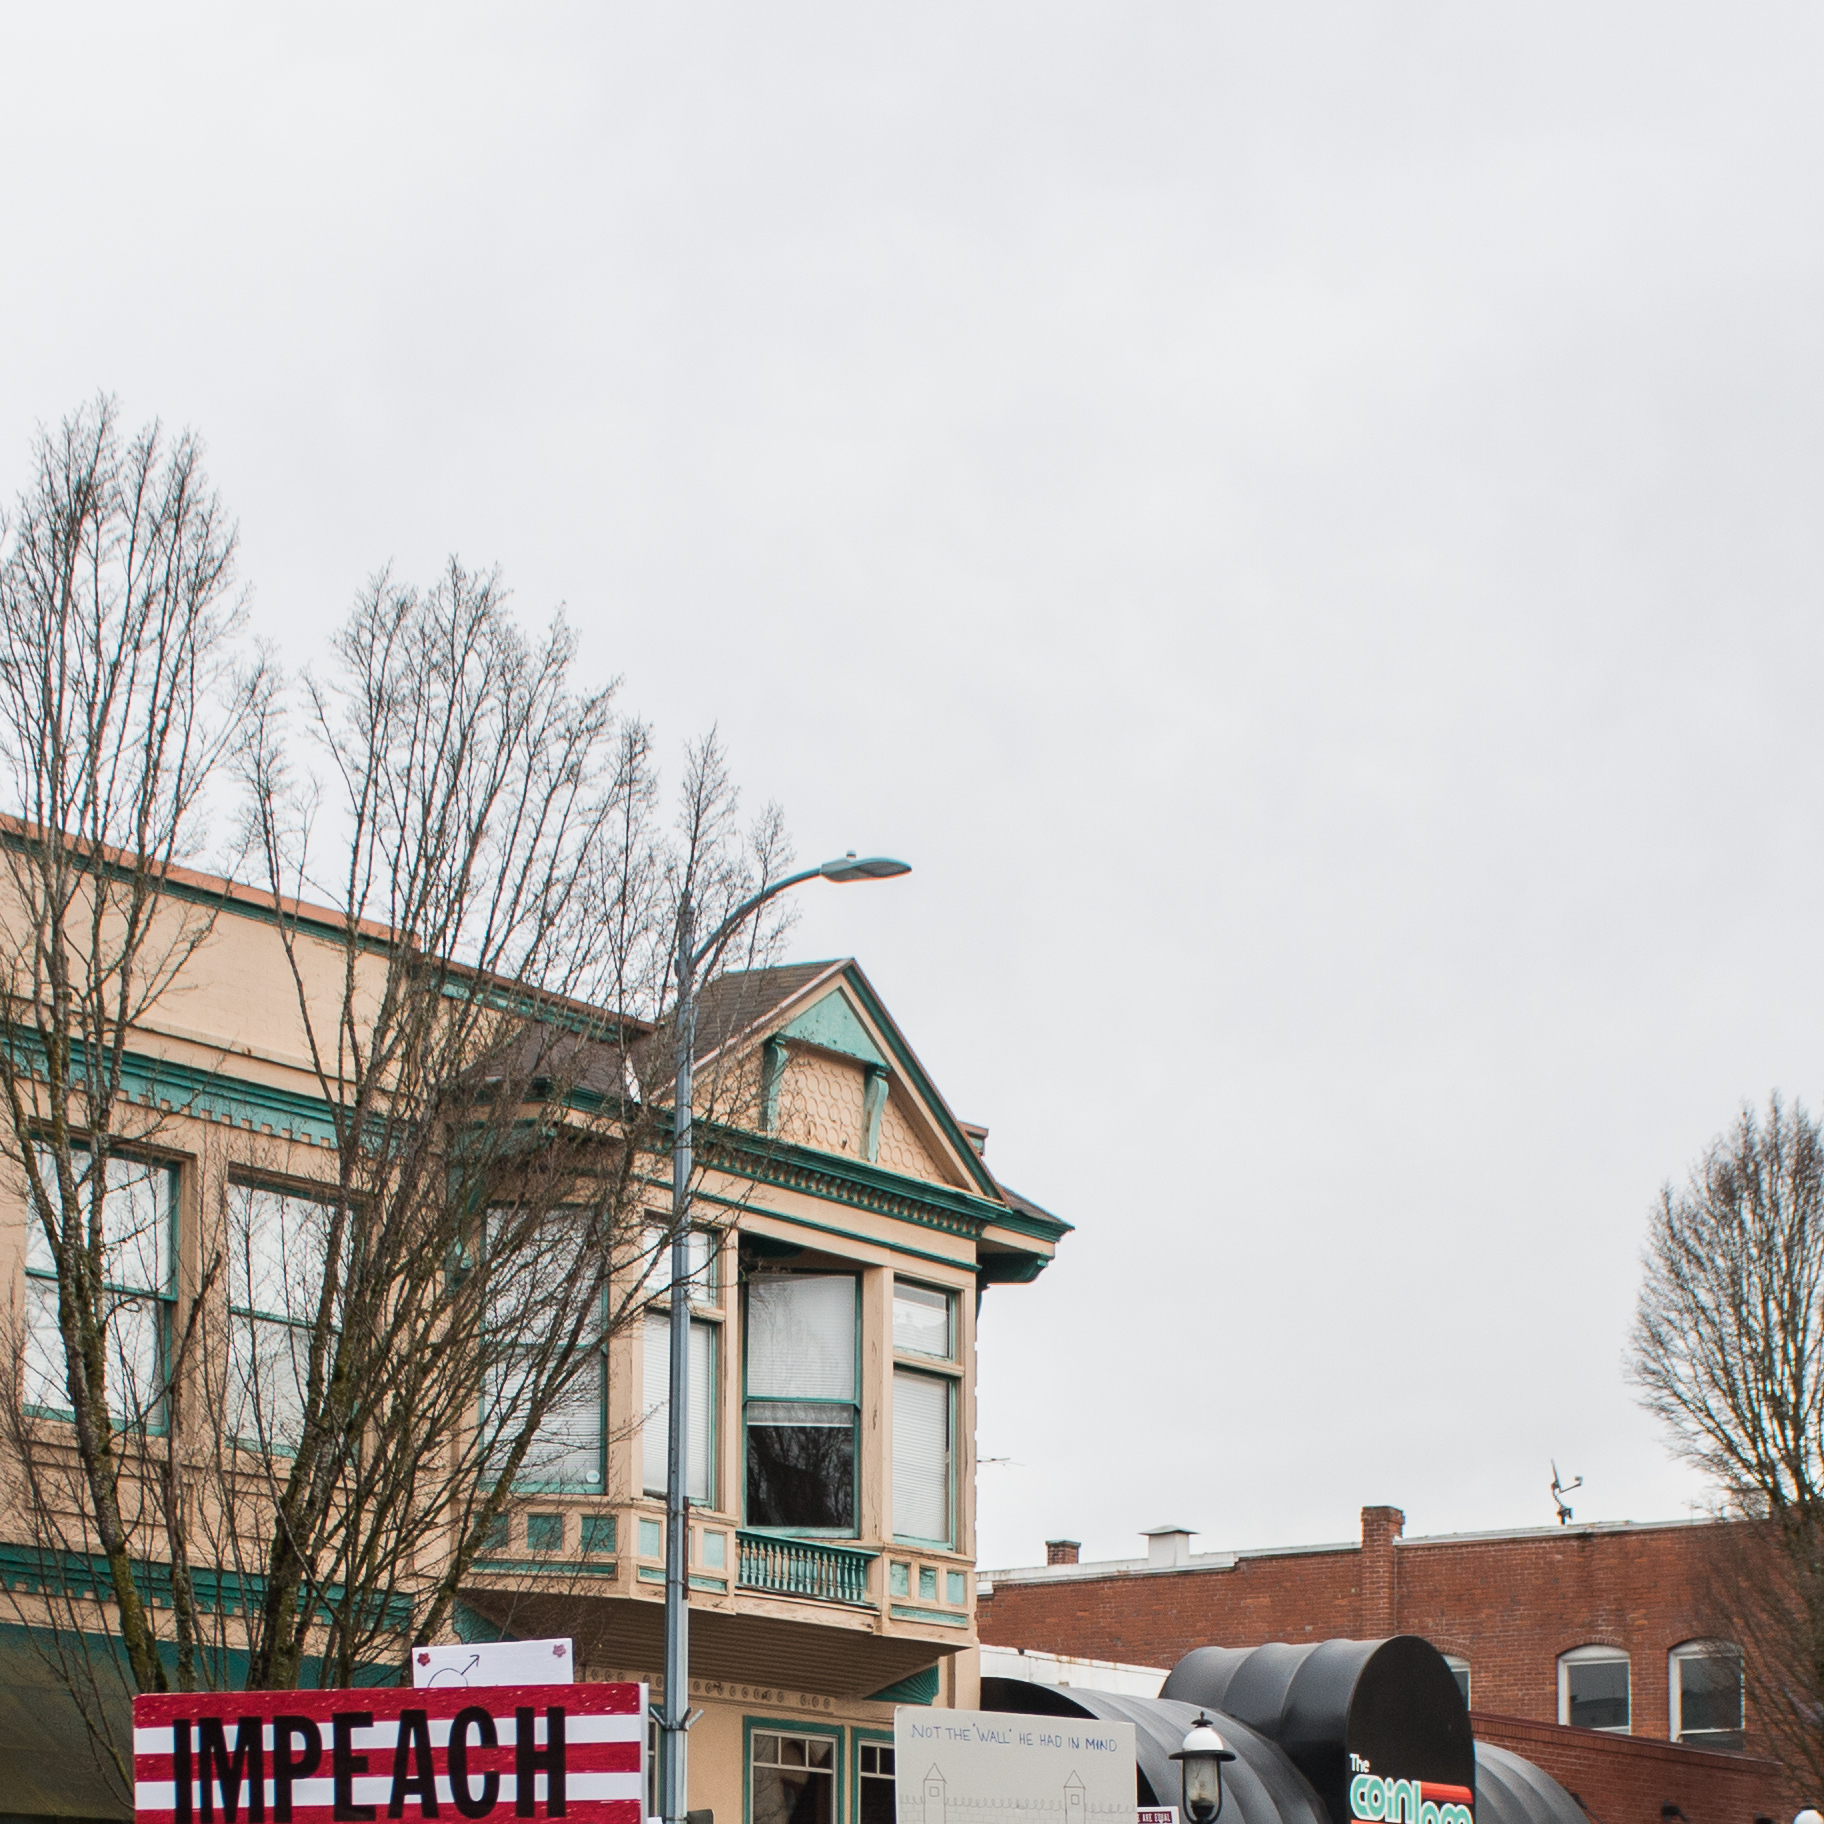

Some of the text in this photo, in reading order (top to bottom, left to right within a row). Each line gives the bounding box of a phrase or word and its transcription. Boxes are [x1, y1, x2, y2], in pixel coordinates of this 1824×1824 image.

[911, 1724, 942, 1739] NOT
[946, 1728, 971, 1741] THE
[1018, 1733, 1033, 1746] HE
[1039, 1733, 1062, 1748] HAD
[1066, 1737, 1080, 1749] IN
[1085, 1738, 1118, 1752] MIND
[1349, 1753, 1370, 1773] The
